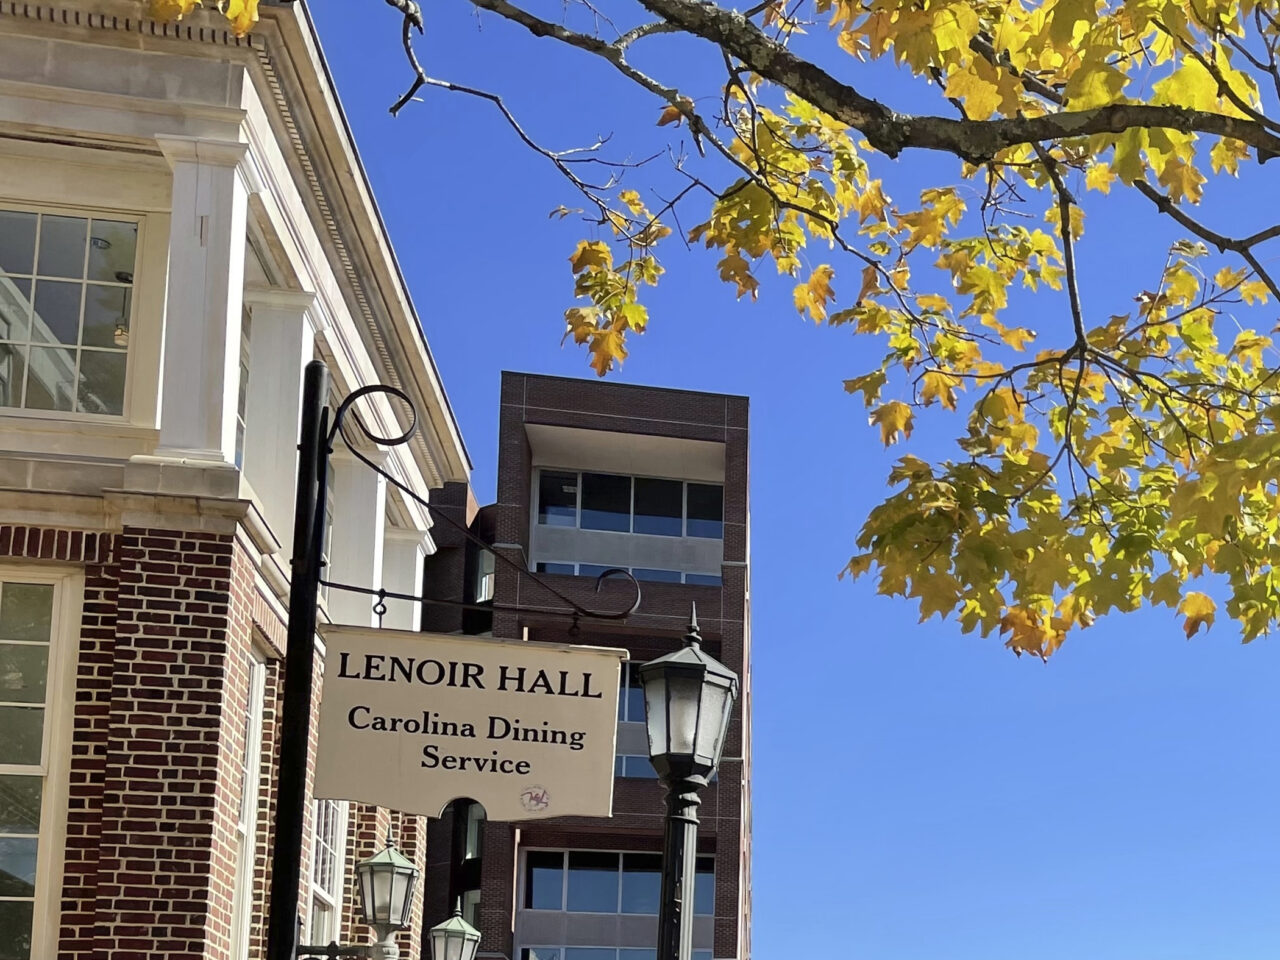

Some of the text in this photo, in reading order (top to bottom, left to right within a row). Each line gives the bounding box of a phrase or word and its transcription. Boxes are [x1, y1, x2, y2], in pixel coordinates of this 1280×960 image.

[337, 652, 603, 699] LENOIR HALL
[348, 705, 586, 750] Carolina Dining
[421, 744, 531, 775] Service
